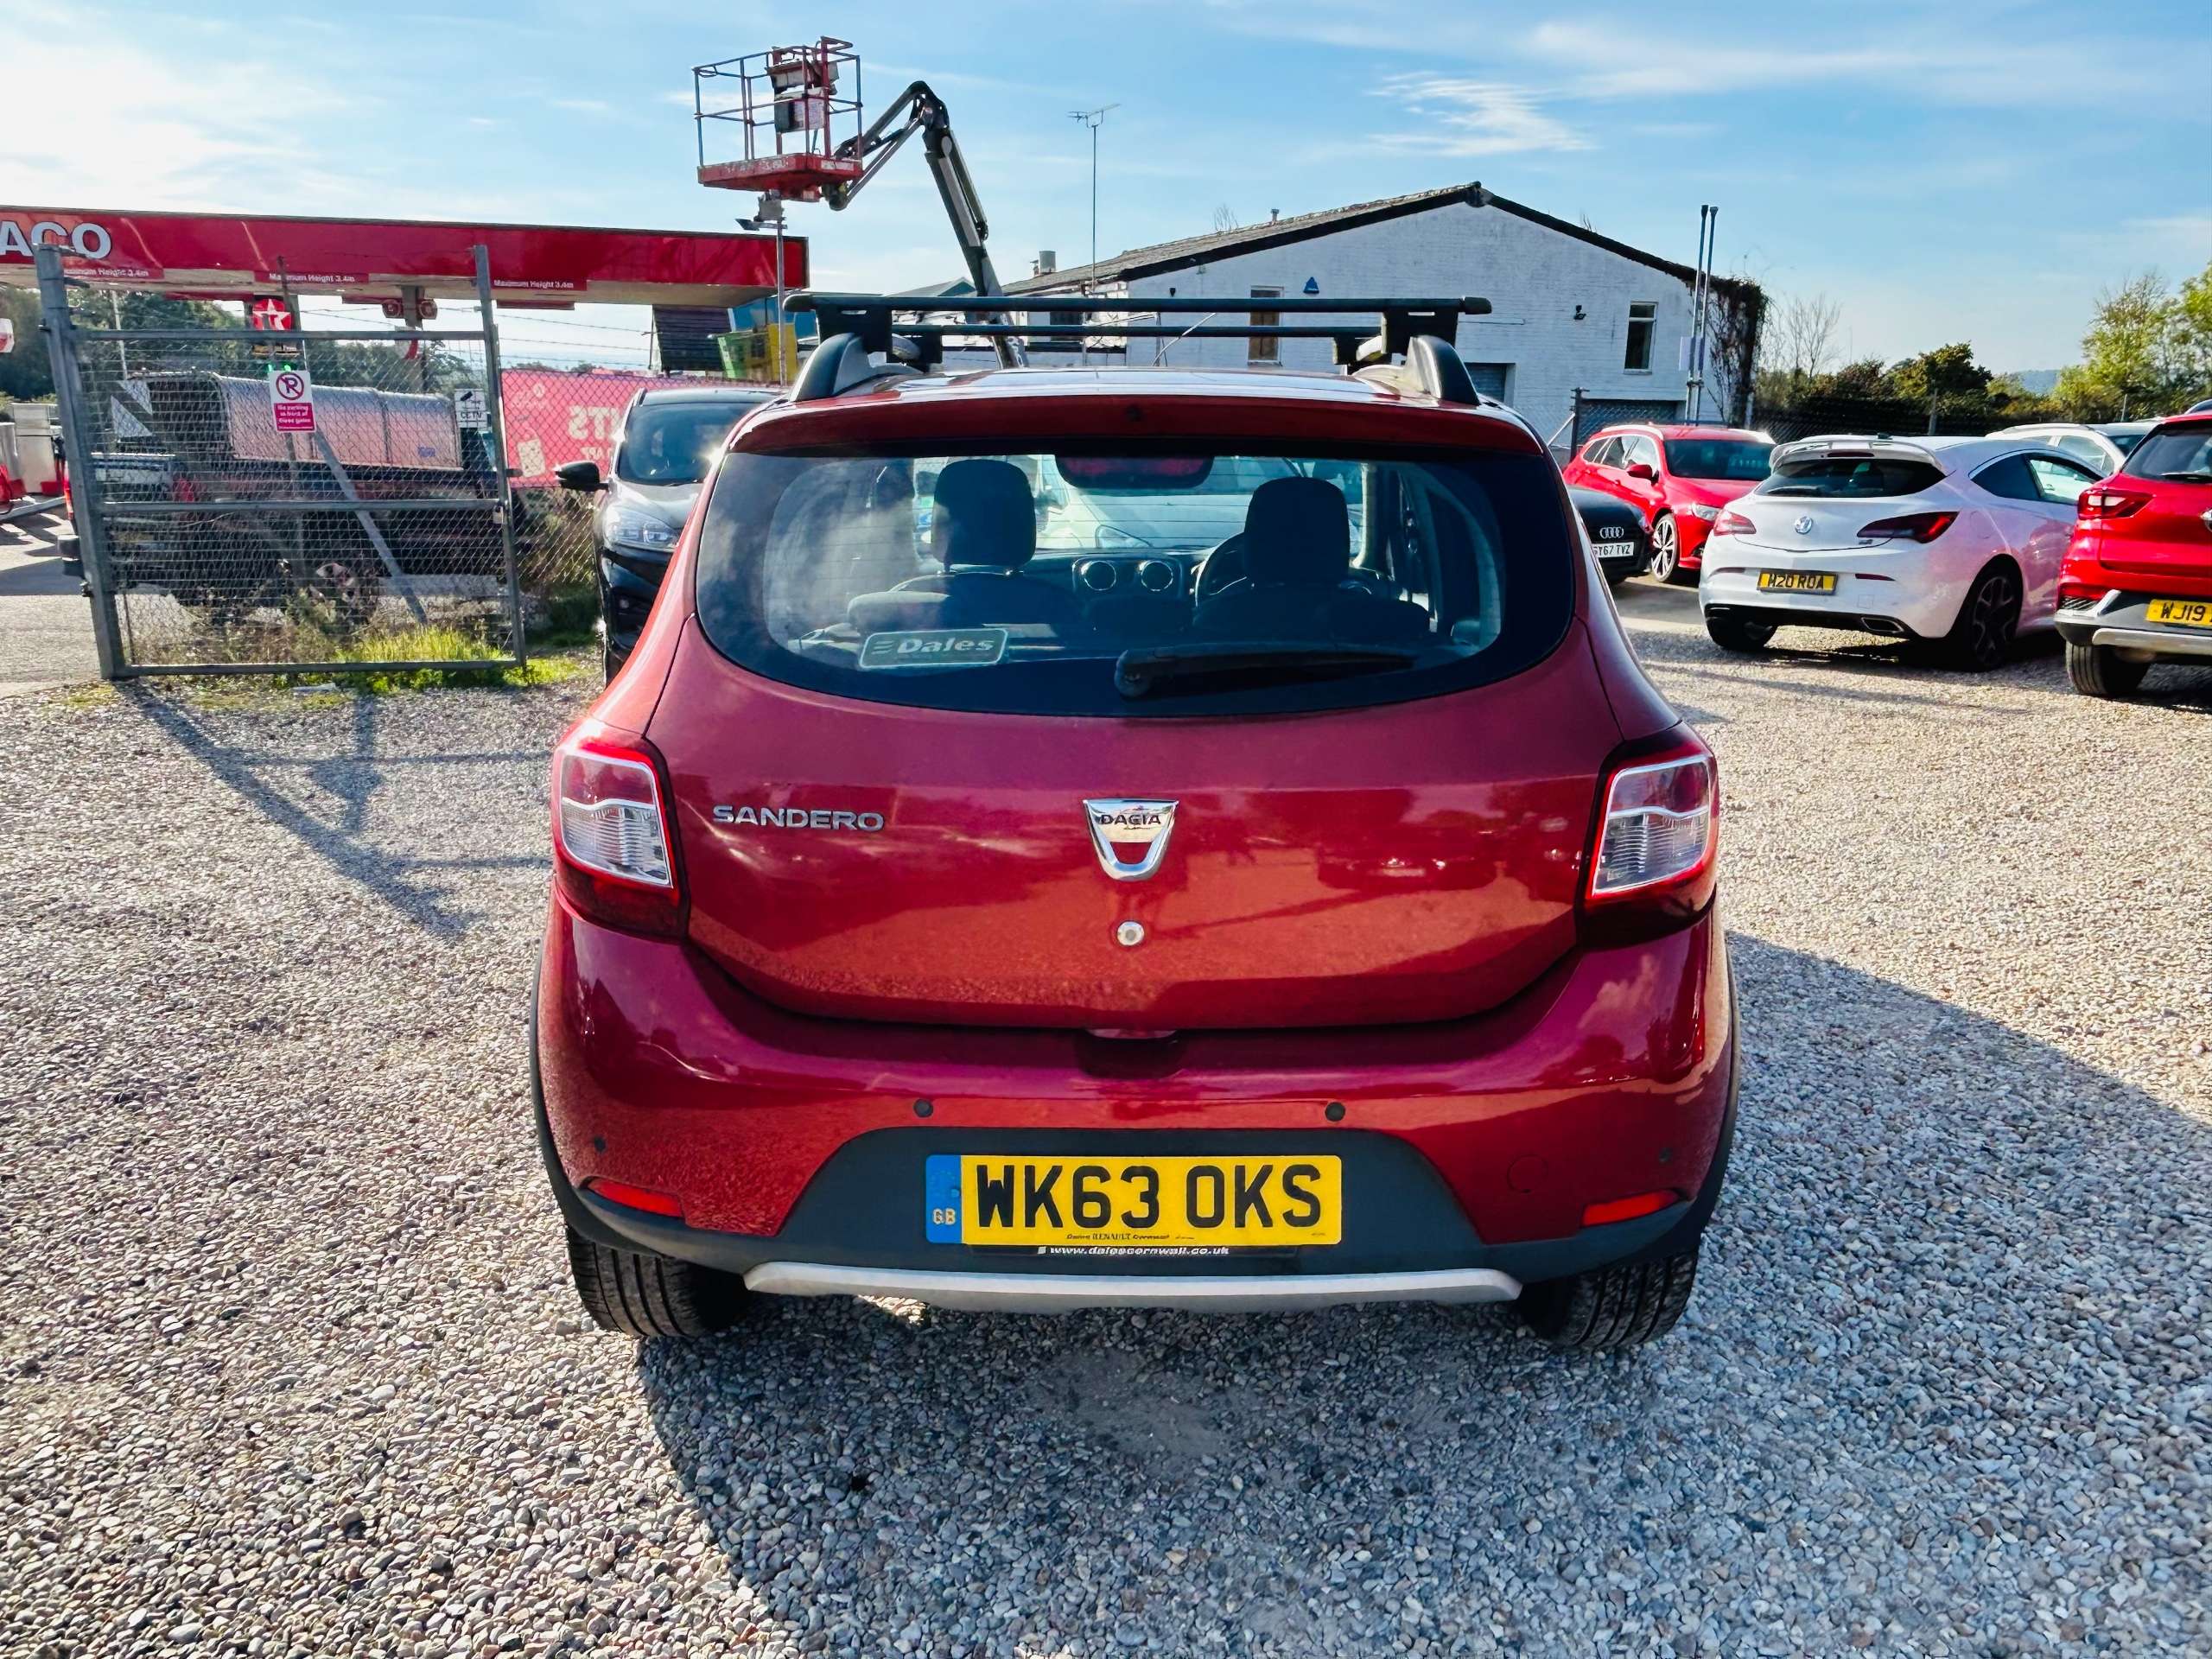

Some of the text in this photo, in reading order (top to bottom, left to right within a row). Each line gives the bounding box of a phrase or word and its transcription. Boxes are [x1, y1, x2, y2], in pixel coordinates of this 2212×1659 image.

[530, 280, 554, 289] Height
[2160, 602, 2206, 622] WJ19
[897, 637, 995, 654] Dales
[713, 805, 885, 831] SANDERO
[1099, 813, 1162, 826] DACIA
[976, 1164, 1321, 1229] WK63 OKS
[932, 1208, 957, 1226] GB
[1050, 1246, 1230, 1255] www.dalescornwall.co.uk
